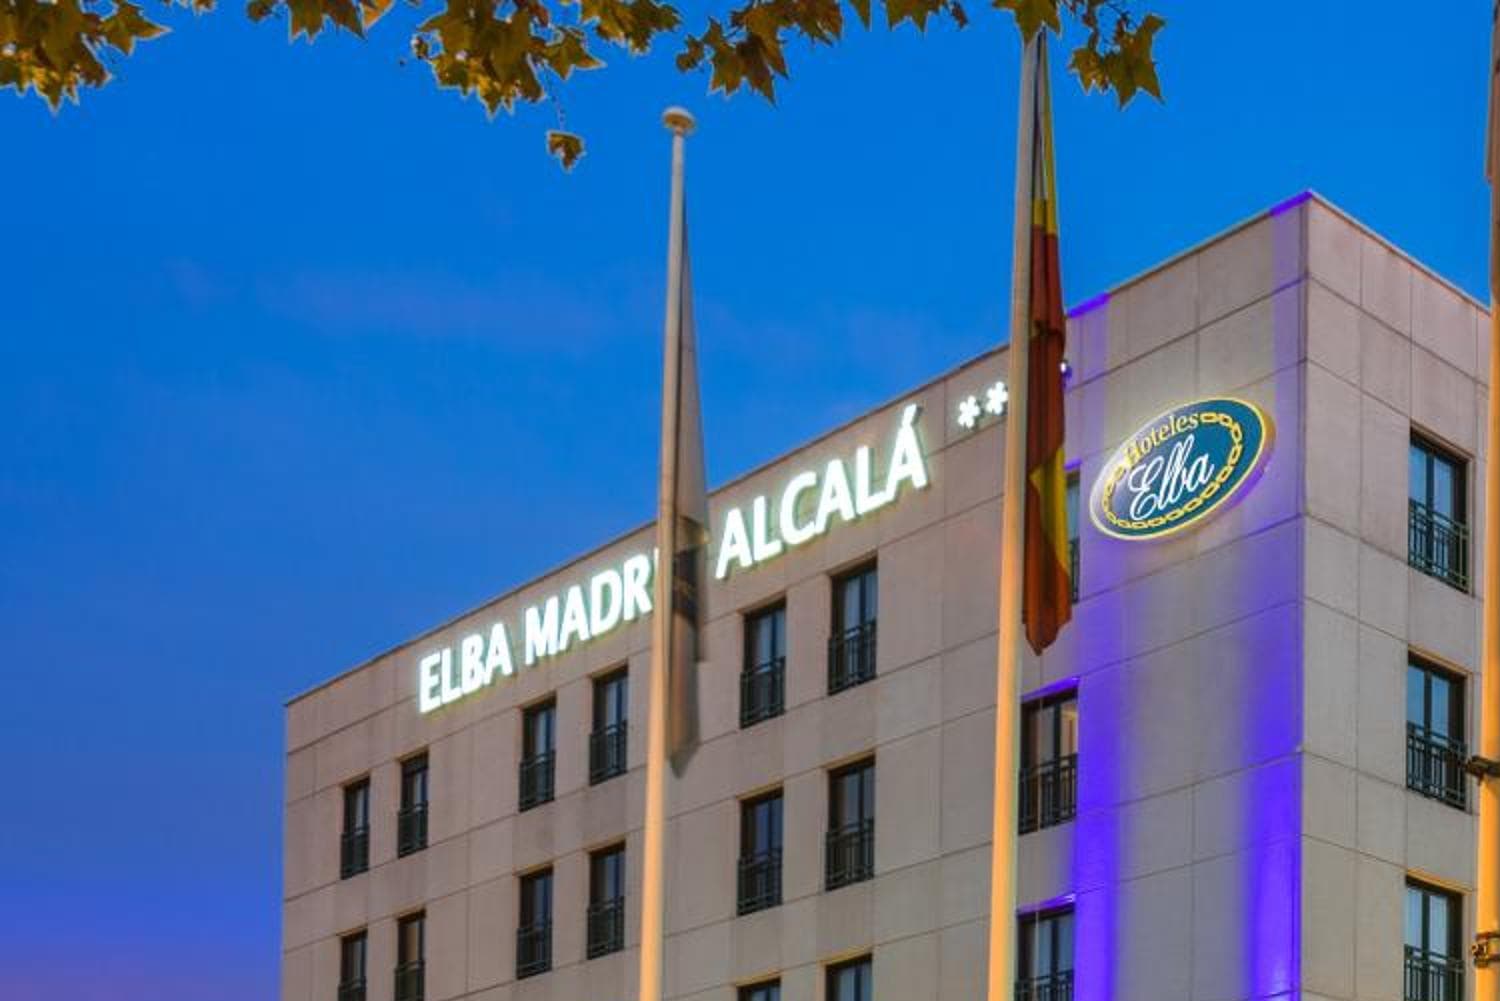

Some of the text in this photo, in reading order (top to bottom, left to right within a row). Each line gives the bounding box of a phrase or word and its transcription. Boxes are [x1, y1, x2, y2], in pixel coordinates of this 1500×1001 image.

[1124, 412, 1200, 466] Hoteles
[1127, 434, 1215, 521] Elba
[419, 403, 927, 714] ELBA MADR ALCALÁ
